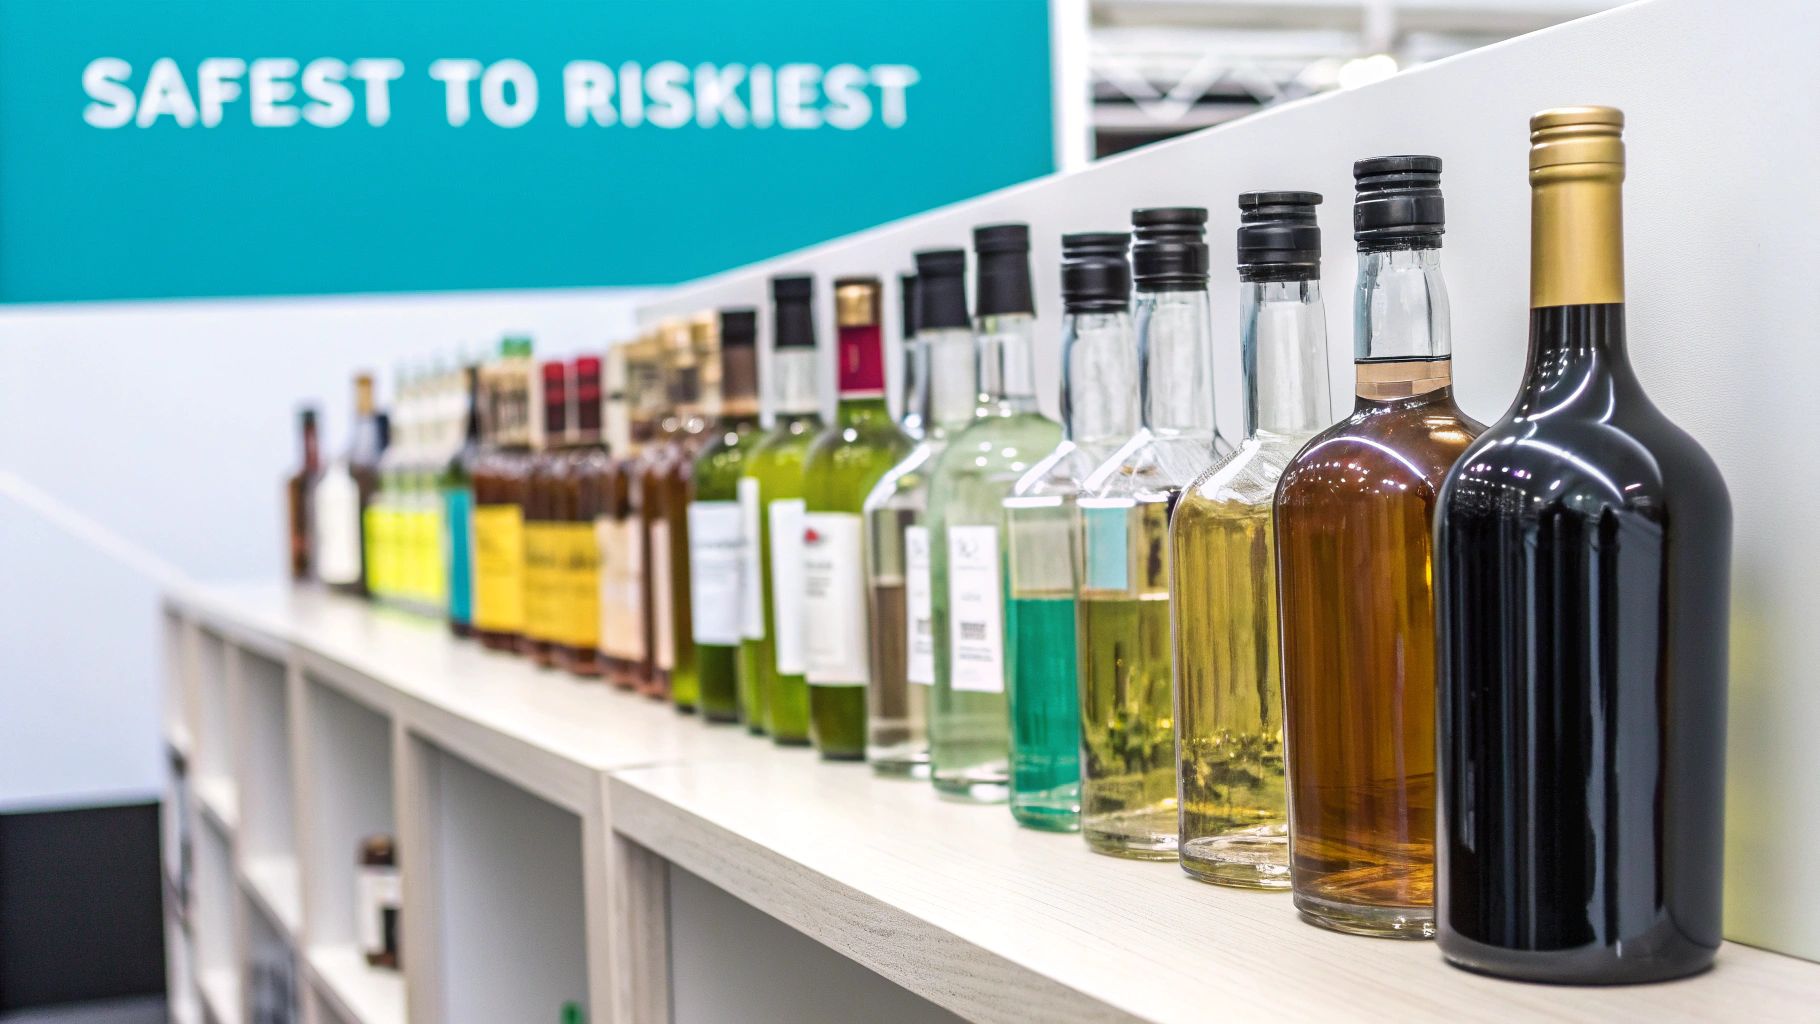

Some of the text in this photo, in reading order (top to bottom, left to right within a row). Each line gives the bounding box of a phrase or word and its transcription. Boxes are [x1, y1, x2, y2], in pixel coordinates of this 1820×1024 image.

[83, 58, 918, 129] SAFEST TO RISKIEST
